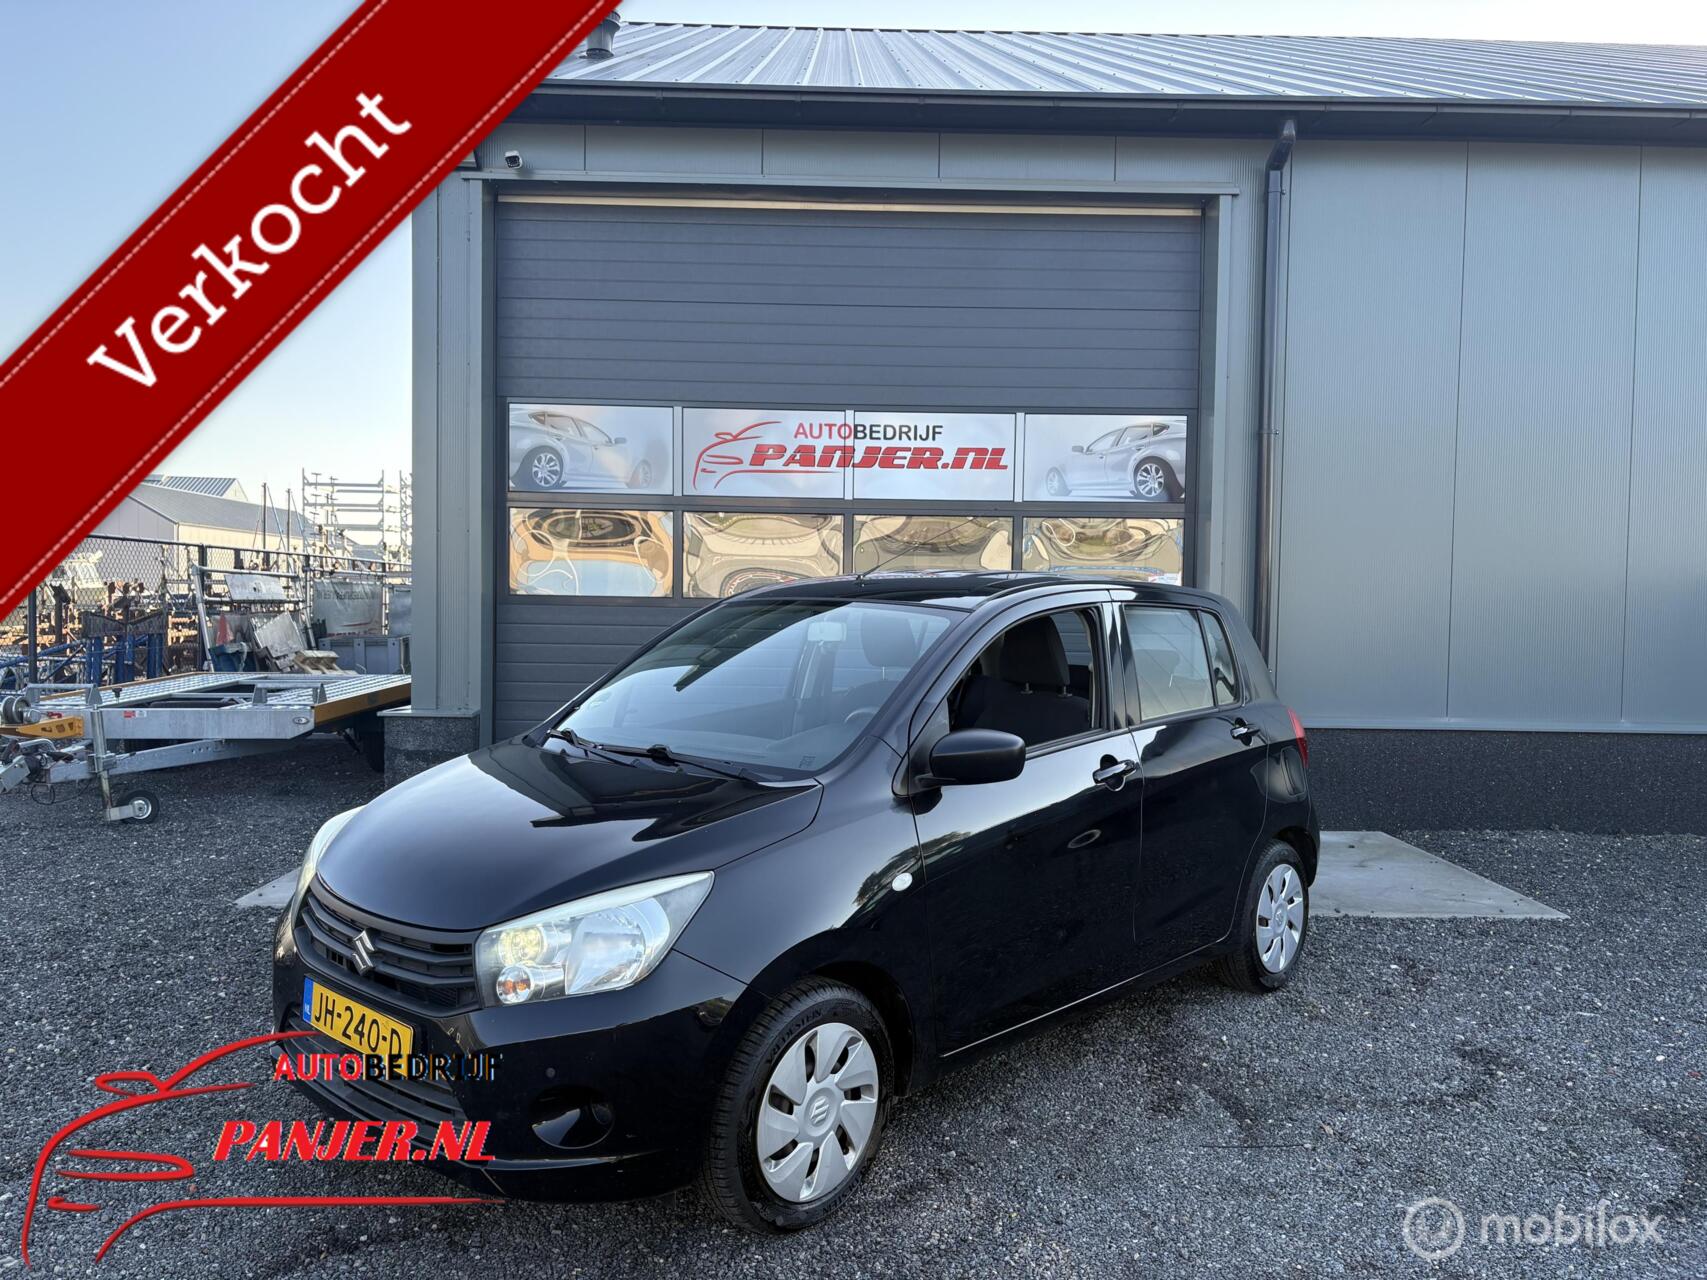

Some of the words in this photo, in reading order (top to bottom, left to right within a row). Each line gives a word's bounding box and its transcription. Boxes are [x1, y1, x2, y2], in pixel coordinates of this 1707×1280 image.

[794, 422, 943, 441] AUTOBEDRIJF
[750, 443, 1008, 470] PANJER.NL
[315, 992, 402, 1061] JH-240-D
